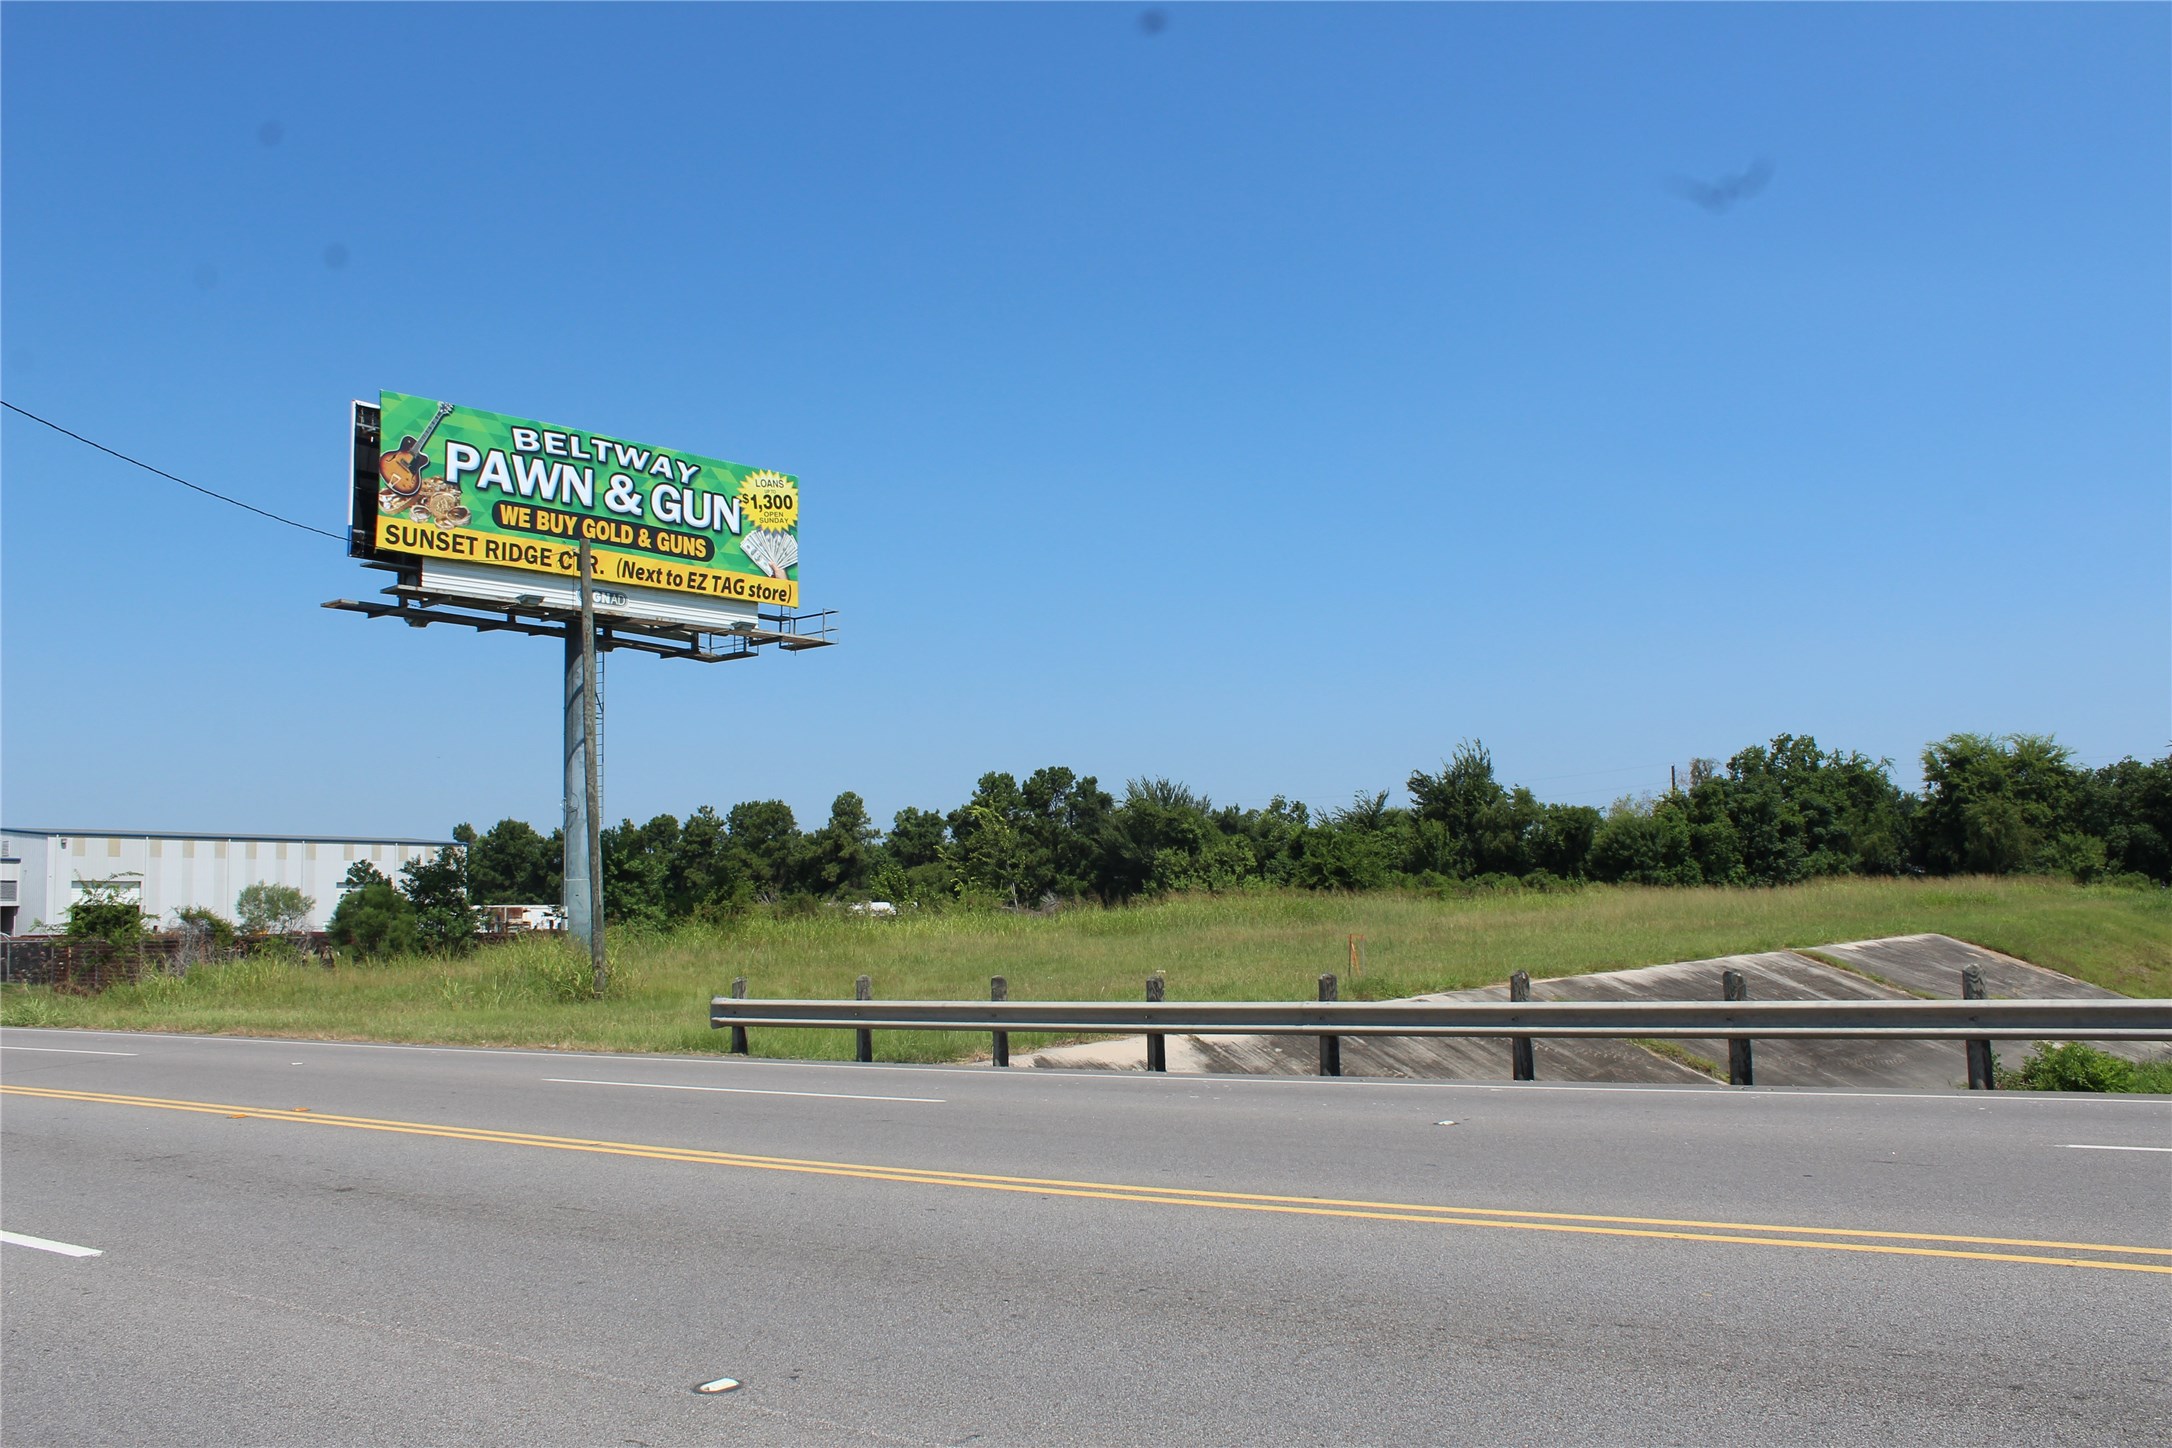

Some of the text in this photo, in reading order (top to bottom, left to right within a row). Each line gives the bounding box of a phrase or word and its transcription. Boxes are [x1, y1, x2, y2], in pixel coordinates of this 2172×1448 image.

[512, 427, 700, 484] BELTWAY
[445, 440, 741, 535] PAWN & GUN
[742, 493, 793, 513] $1,300
[755, 479, 785, 488] LOANS
[500, 504, 707, 558] WE BUY GOLD & GUNS
[385, 524, 478, 555] SUNSET
[485, 539, 553, 567] RIDGE
[617, 557, 662, 583] (Next
[666, 569, 683, 587] to
[687, 571, 709, 591] EZ
[712, 575, 745, 596] TAG
[748, 583, 792, 604] store)
